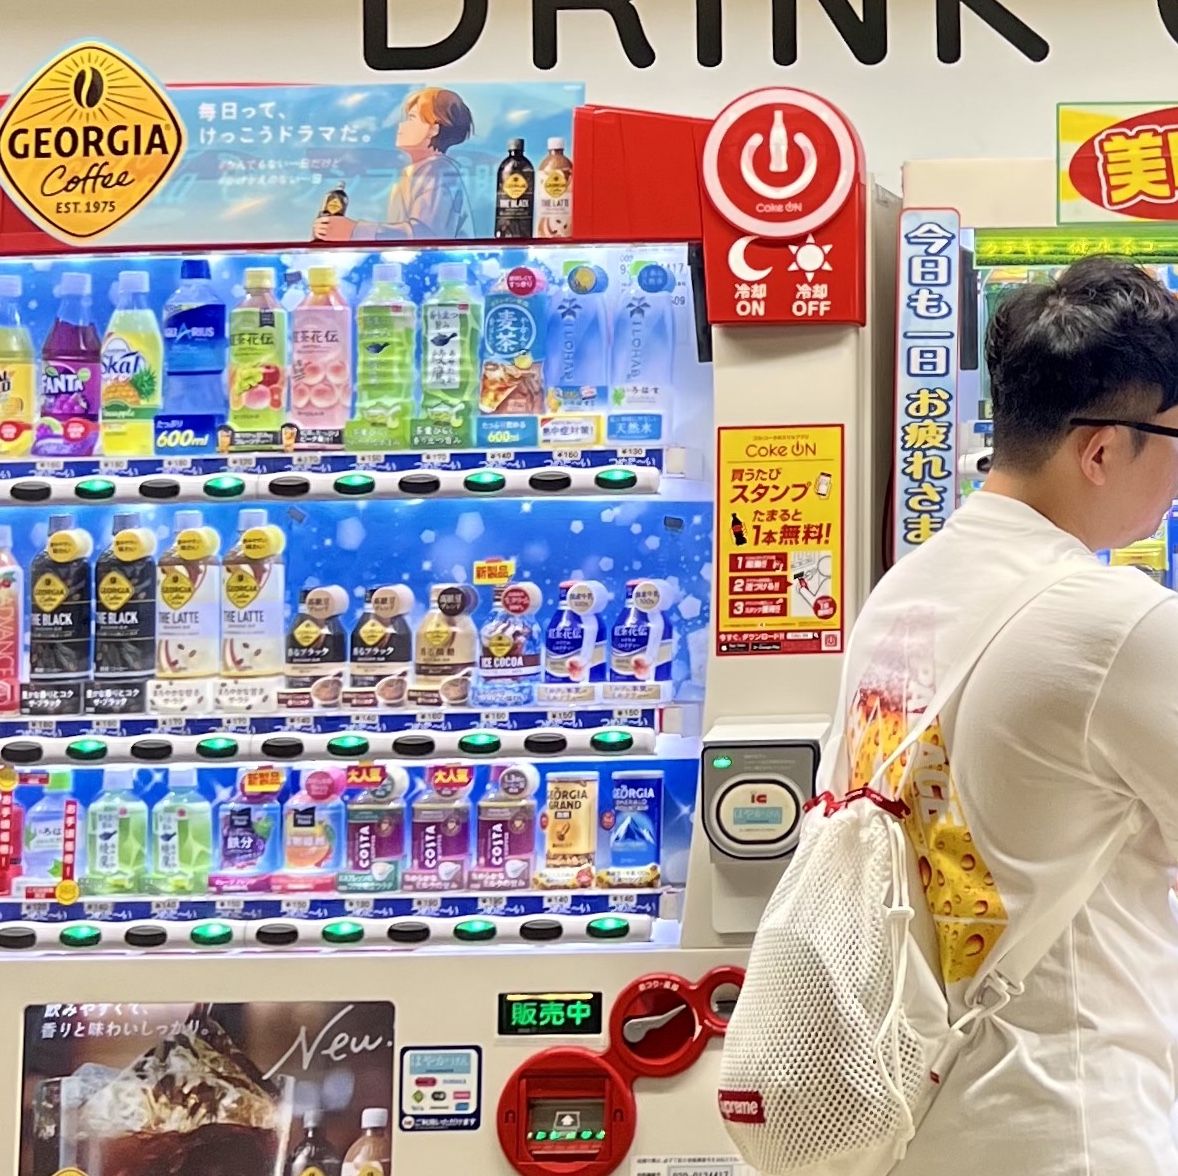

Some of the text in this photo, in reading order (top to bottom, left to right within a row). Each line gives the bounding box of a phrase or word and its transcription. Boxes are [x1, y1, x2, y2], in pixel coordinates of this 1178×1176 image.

[198, 101, 286, 122] 毎日って、
[8, 123, 169, 159] GEORGIA
[200, 124, 373, 145] けっこうドラマだ。
[41, 161, 136, 197] Coffee
[56, 200, 116, 214] EST. 1975
[755, 201, 803, 214] Coke ON
[734, 283, 767, 299] 冷却
[796, 283, 829, 299] 冷却
[735, 300, 766, 316] ON
[791, 300, 832, 317] OFF
[496, 310, 522, 353] 麦茶
[616, 423, 652, 435] 天然水
[156, 430, 208, 448] 600ml
[745, 440, 817, 458] Coke ON
[731, 468, 782, 483] 買うたび
[730, 482, 811, 504] スタンプ
[752, 509, 802, 522] たまると
[753, 523, 832, 547] 1本無料!
[736, 556, 743, 568] 1
[475, 564, 509, 579] 新製品
[733, 579, 744, 592] 2
[733, 601, 743, 615] 3
[43, 612, 74, 625] BLACK
[108, 611, 139, 624] BLACK
[172, 611, 200, 624] LATTE
[493, 657, 524, 668] COCOA
[348, 768, 382, 783] 大人気
[435, 768, 470, 783] 大人気
[227, 836, 253, 849] 鉄分
[358, 825, 370, 868] COSTA
[424, 824, 437, 868] COSTA
[491, 823, 503, 866] COSTA
[511, 1001, 592, 1027] 販売中
[41, 1020, 210, 1040] 香りと味わいしっかり。
[720, 1098, 759, 1117] upreme
